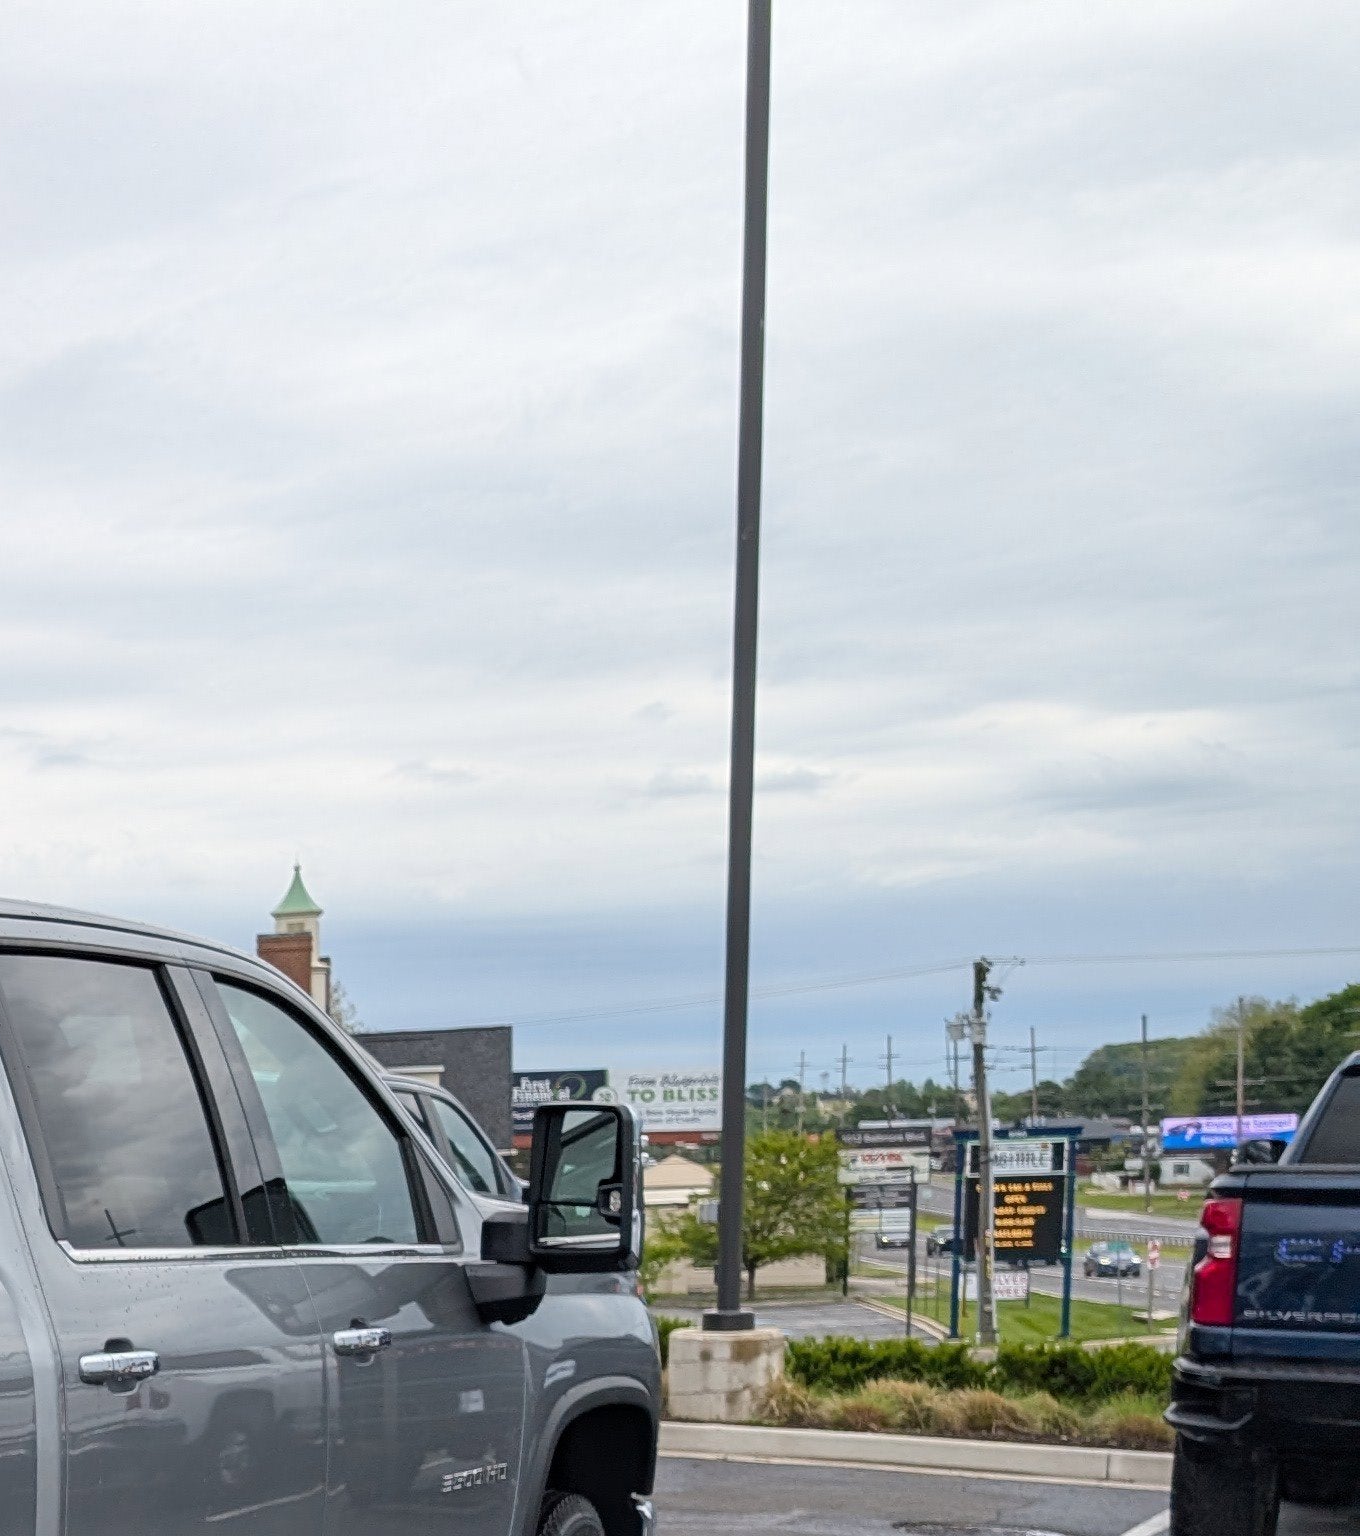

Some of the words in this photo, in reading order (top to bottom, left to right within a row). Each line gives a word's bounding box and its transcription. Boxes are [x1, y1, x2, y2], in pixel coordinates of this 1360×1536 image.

[627, 1089, 656, 1102] TO
[662, 1088, 719, 1102] BLISS
[1243, 1309, 1360, 1323] SILVERAD
